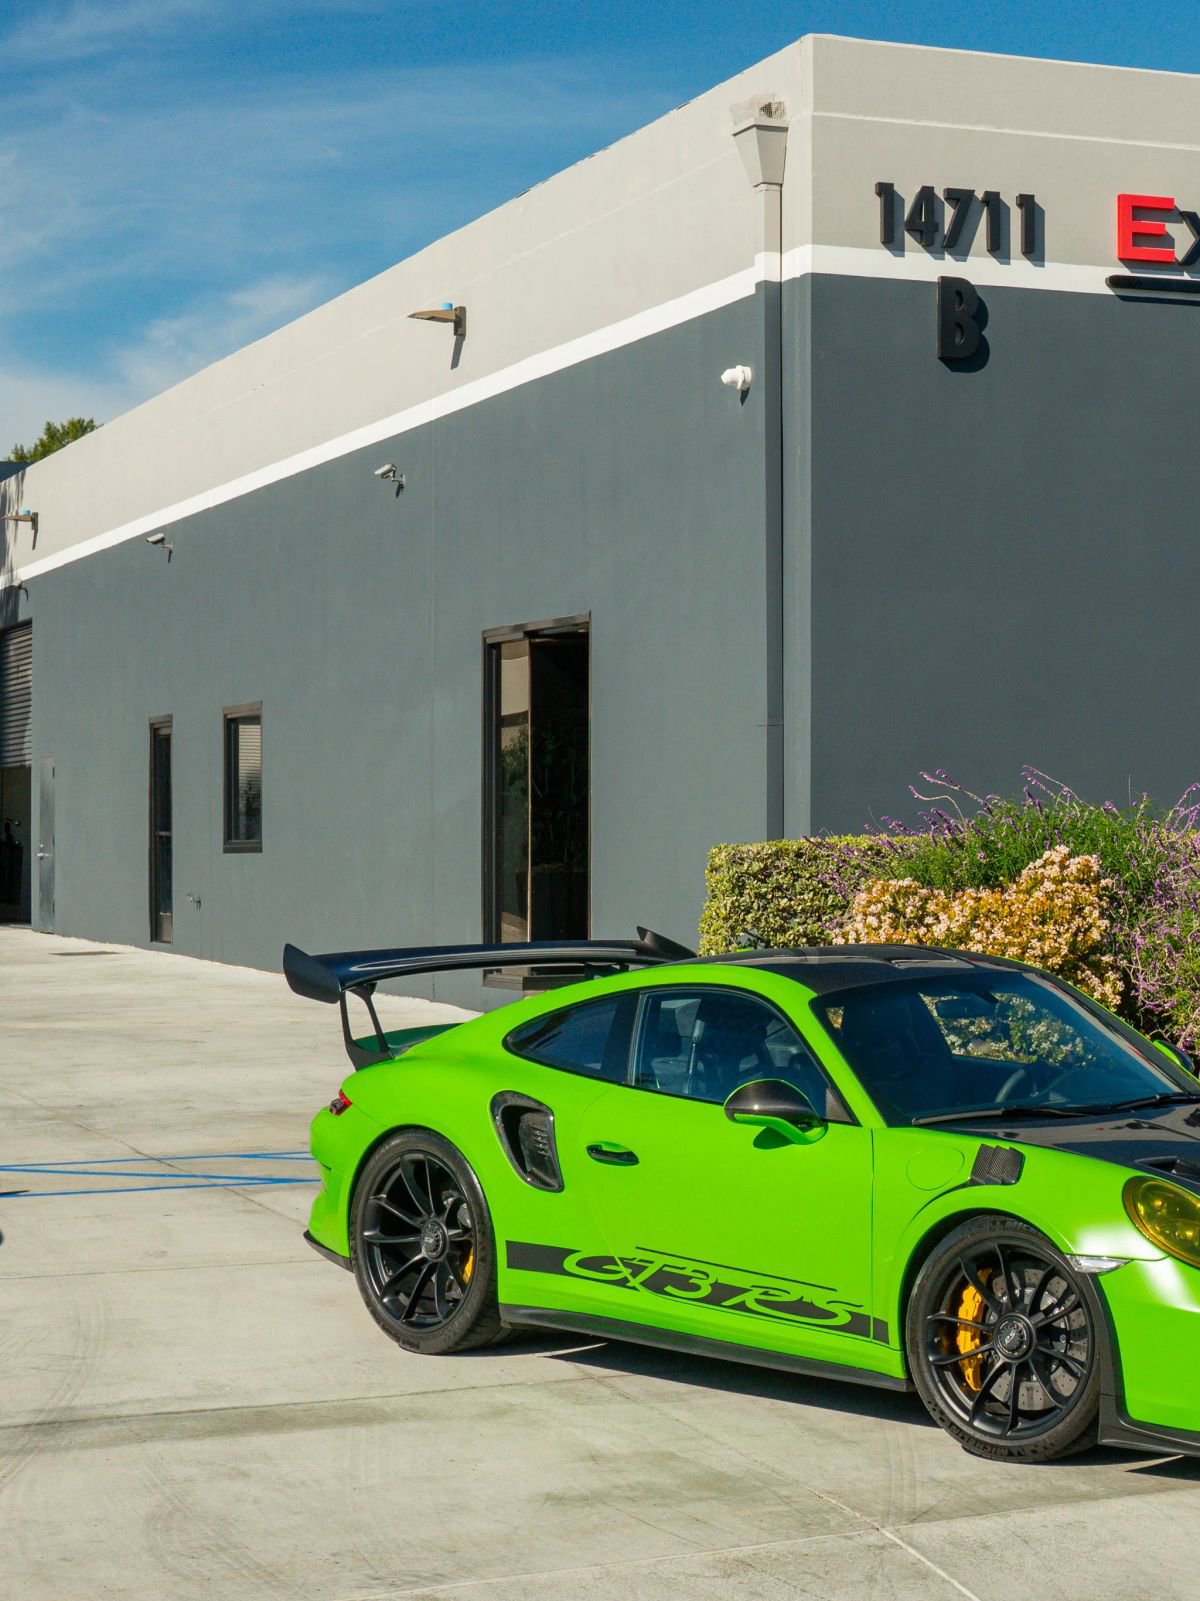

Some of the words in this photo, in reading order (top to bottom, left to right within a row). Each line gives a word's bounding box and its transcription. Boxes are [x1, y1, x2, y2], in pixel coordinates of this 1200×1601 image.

[875, 182, 1036, 255] 14711
[937, 275, 980, 360] B
[562, 1250, 719, 1300] GT3
[722, 1285, 864, 1326] RS
